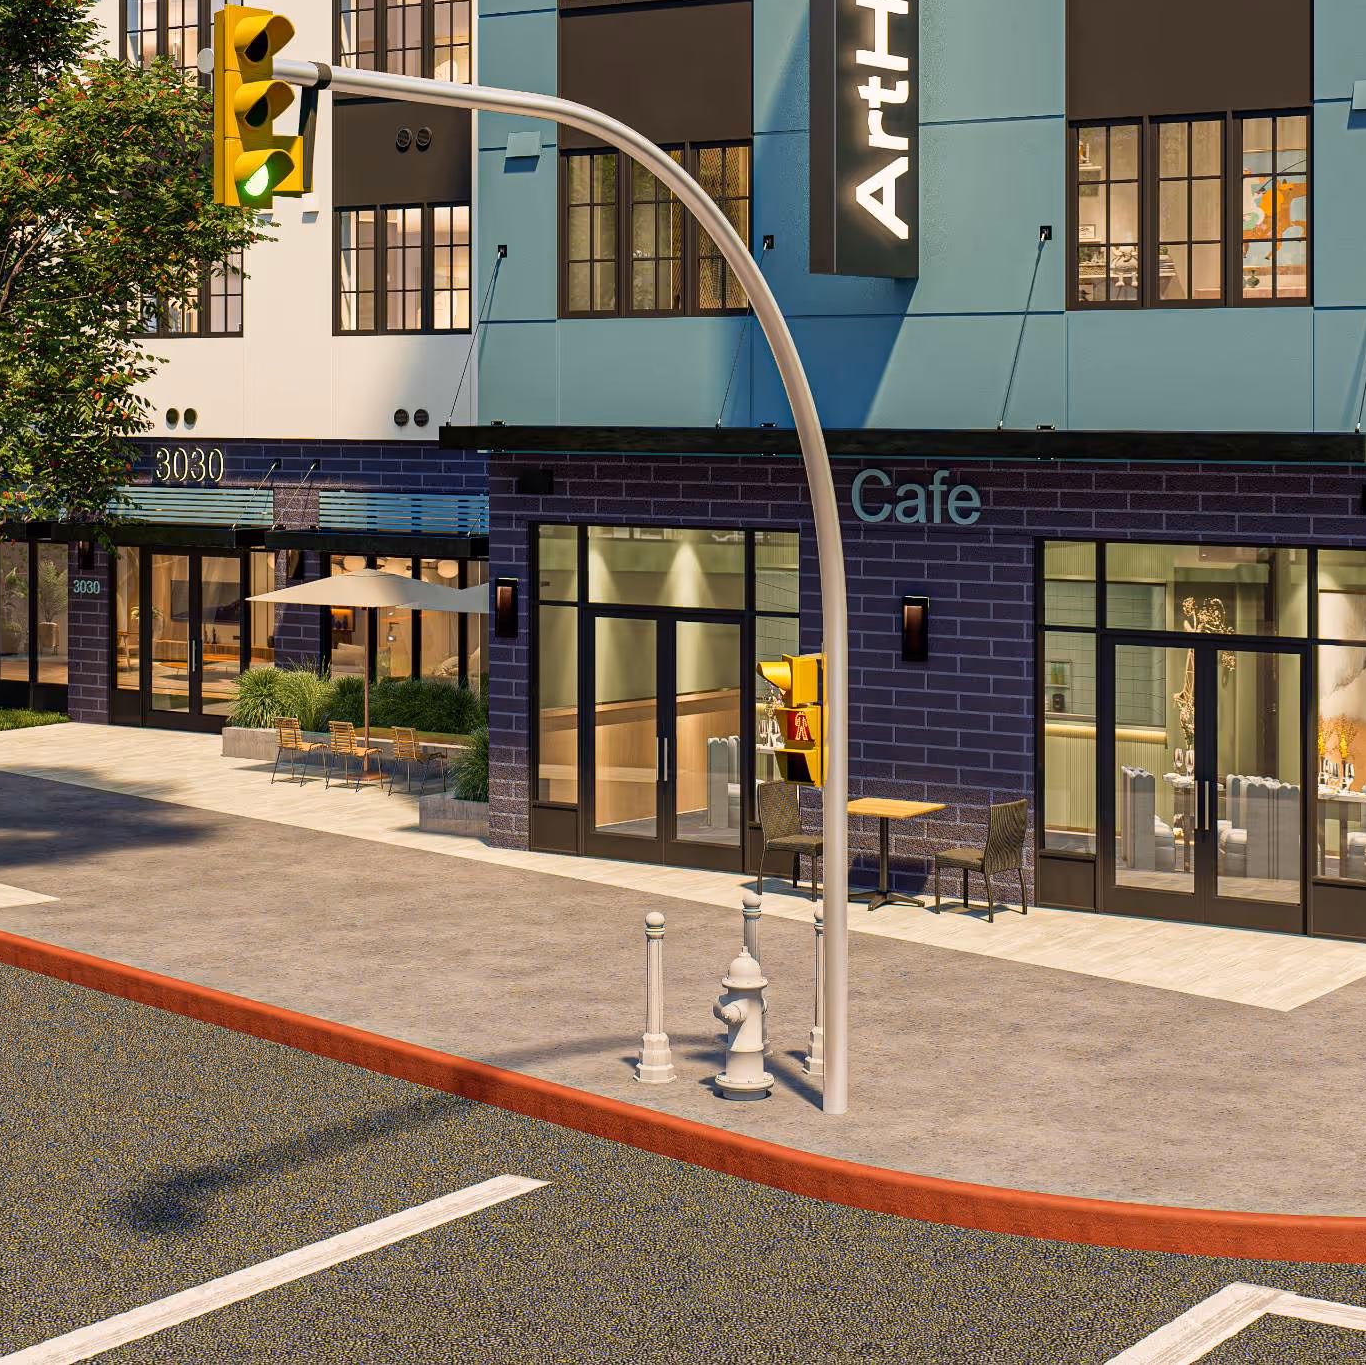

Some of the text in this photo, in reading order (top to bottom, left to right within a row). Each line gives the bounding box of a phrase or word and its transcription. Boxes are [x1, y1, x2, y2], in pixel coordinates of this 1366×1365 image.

[155, 446, 224, 483] 3030
[851, 468, 982, 525] Cafe
[73, 579, 101, 594] 3030
